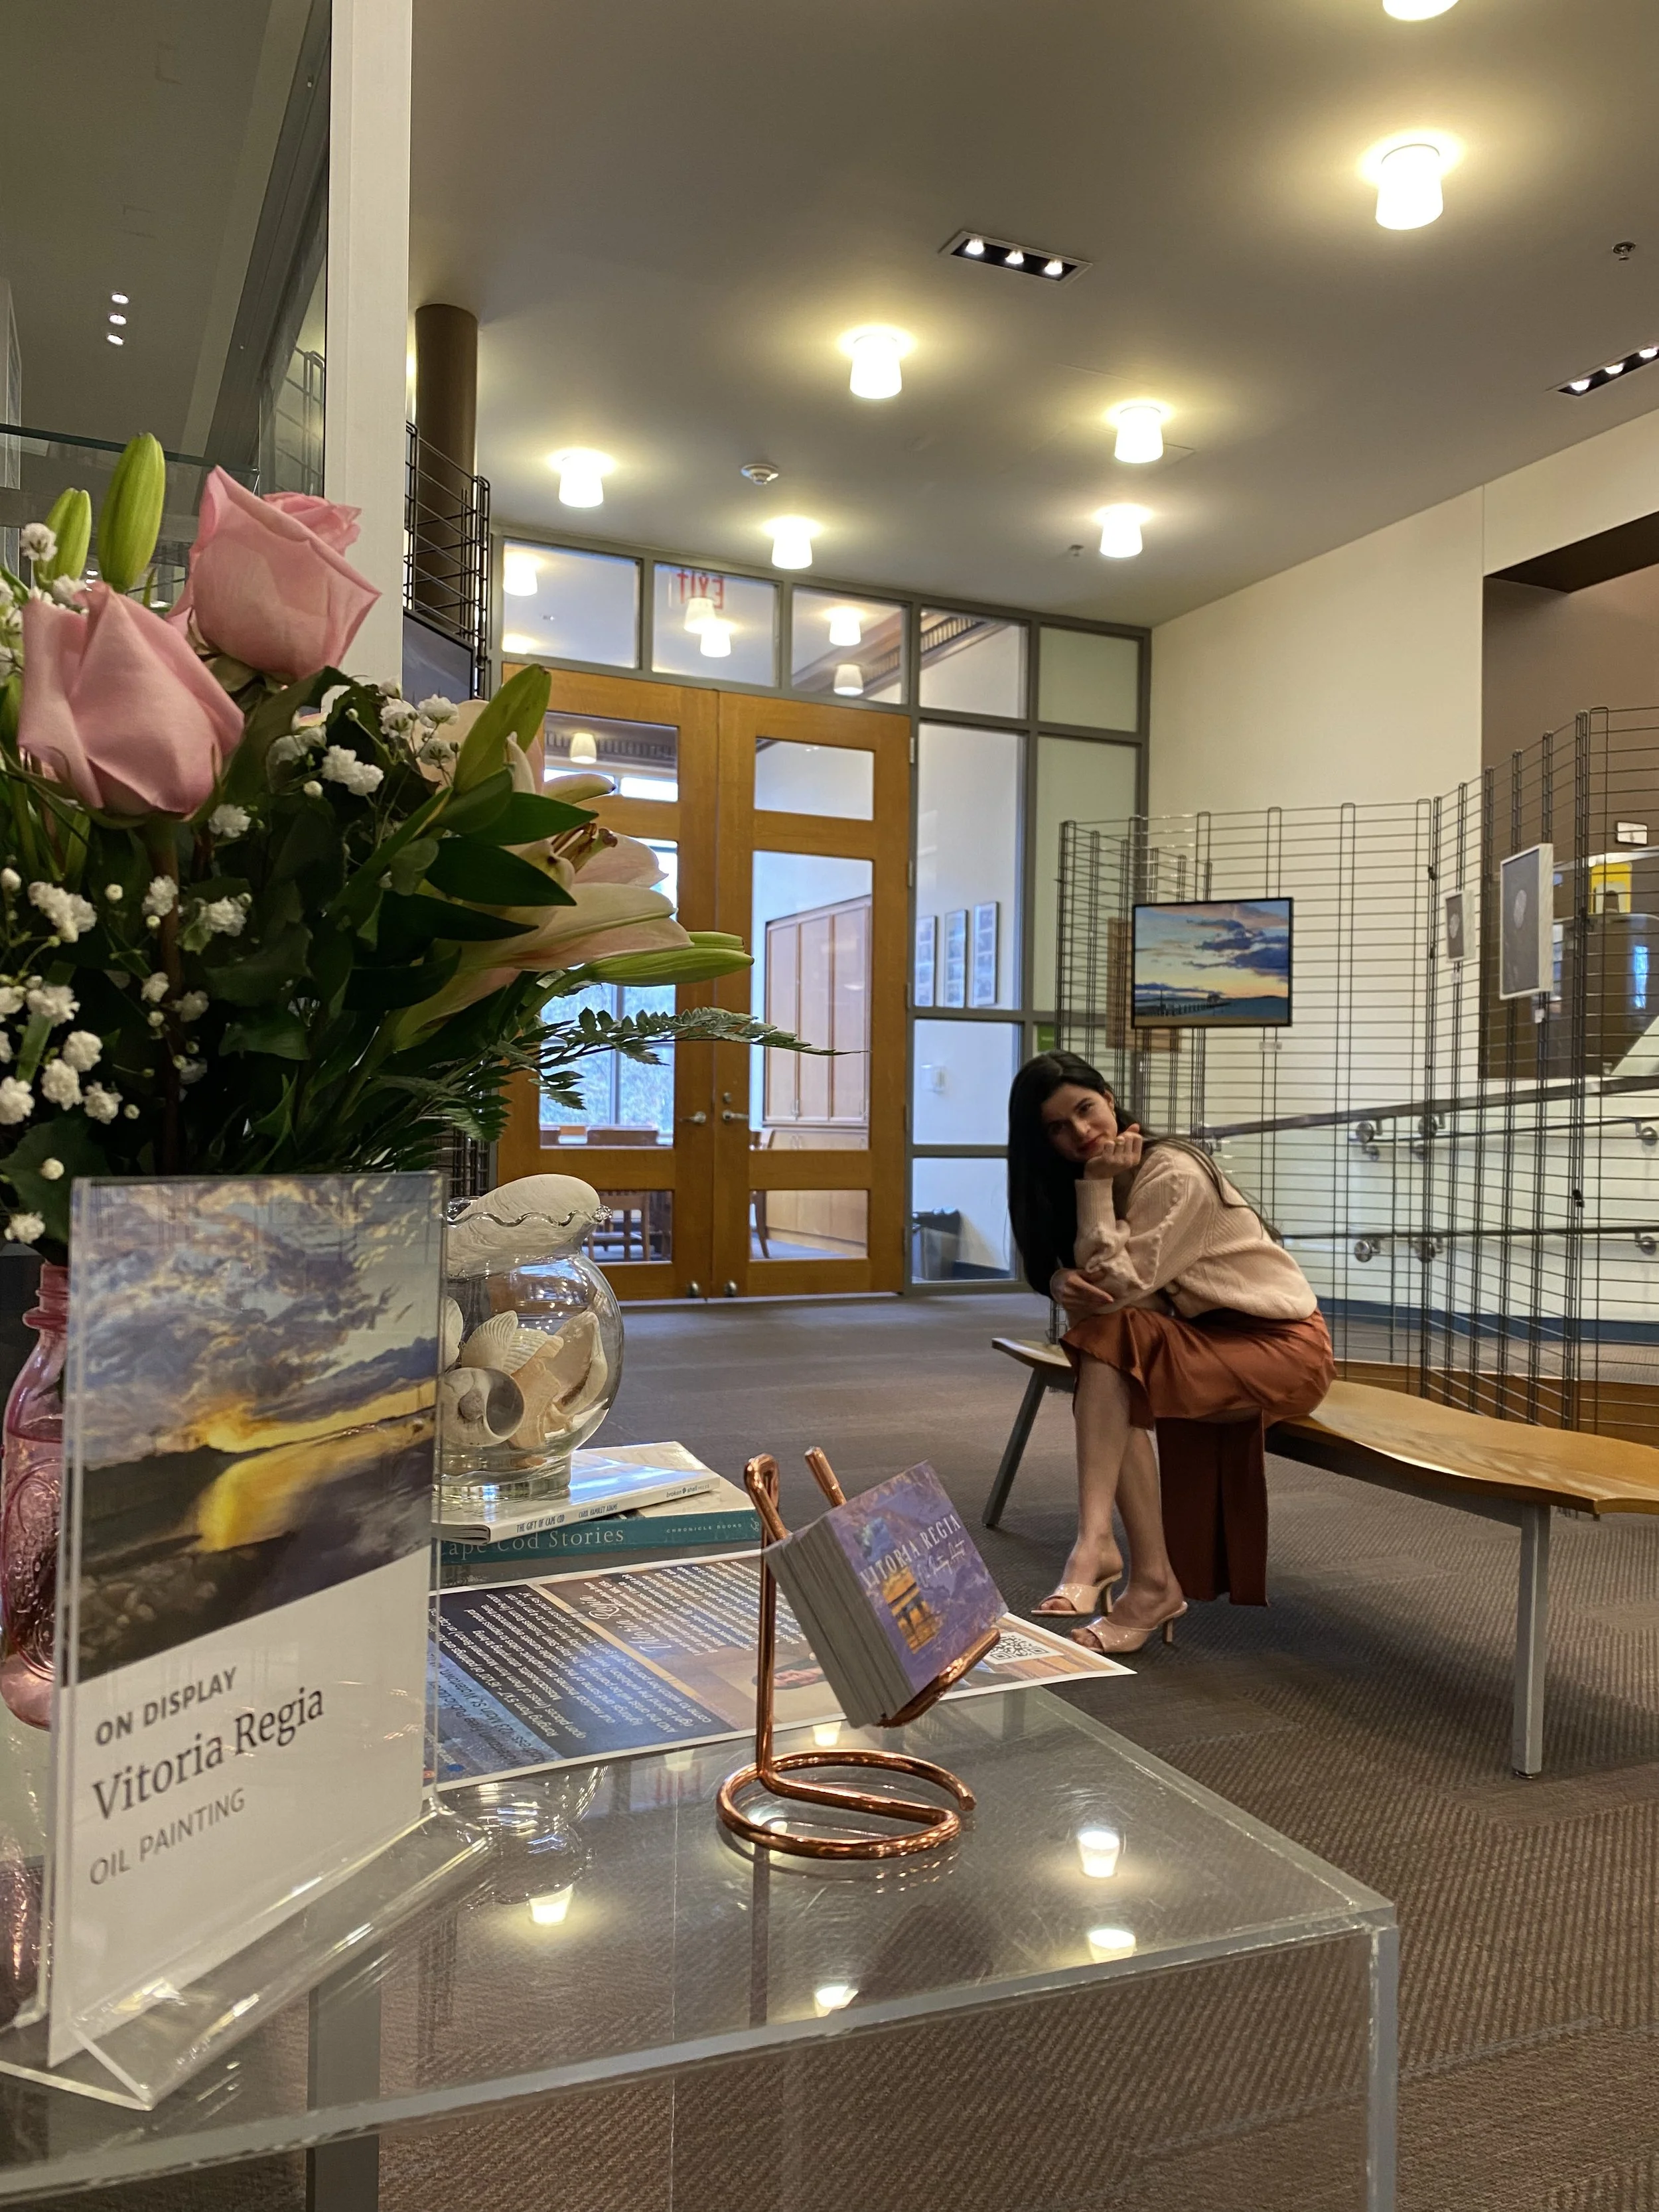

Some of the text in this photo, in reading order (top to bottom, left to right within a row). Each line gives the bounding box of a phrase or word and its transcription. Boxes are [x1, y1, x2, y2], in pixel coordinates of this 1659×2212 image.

[516, 1522, 525, 1532] THE
[526, 1520, 537, 1530] GIFT
[538, 1518, 544, 1528] OF
[545, 1516, 556, 1526] CAPE
[549, 1527, 624, 1548] Stories
[860, 1540, 920, 1588] VITORIA
[920, 1514, 961, 1550] REGIA
[486, 1594, 502, 1603] room
[464, 1609, 486, 1622] natural
[508, 1610, 526, 1621] Room
[548, 1611, 572, 1623] person
[482, 1621, 504, 1635] express
[490, 1614, 525, 1635] experienced
[522, 1621, 545, 1636] Trustees
[579, 1595, 672, 1653] Vitoria Regia
[472, 1631, 490, 1641] bring
[554, 1629, 571, 1639] from
[579, 1633, 598, 1643] know
[505, 1640, 524, 1651] colors
[520, 1635, 543, 1650] sunsets
[567, 1639, 600, 1657] Saturday
[451, 1648, 482, 1666] paintings
[468, 1645, 499, 1666] Monument
[490, 1645, 522, 1666] attempting
[520, 1652, 547, 1668] euphoric
[540, 1650, 569, 1669] incredible
[494, 1666, 512, 1676] from
[540, 1668, 558, 1677] and
[586, 1667, 618, 1686] painting
[620, 1662, 655, 1680] painting
[507, 1676, 526, 1688] them
[554, 1678, 580, 1695] themes
[581, 1682, 603, 1695] some
[526, 1693, 551, 1708] (most
[595, 1694, 615, 1704] and
[658, 1688, 682, 1702] watch
[95, 1666, 238, 1746] ON DISPLAY
[514, 1702, 534, 1715] from
[573, 1696, 604, 1714] nautical
[628, 1700, 650, 1713] artist
[646, 1698, 677, 1715] behind
[545, 1709, 573, 1725] places
[646, 1714, 662, 1722] the
[687, 1708, 711, 1722] come
[529, 1715, 559, 1736] Ranging
[565, 1726, 586, 1738] open
[656, 1722, 678, 1732] AND
[92, 1733, 224, 1820] Vitoria
[234, 1686, 325, 1756] Regia
[90, 1787, 246, 1885] OIL PAINTING
